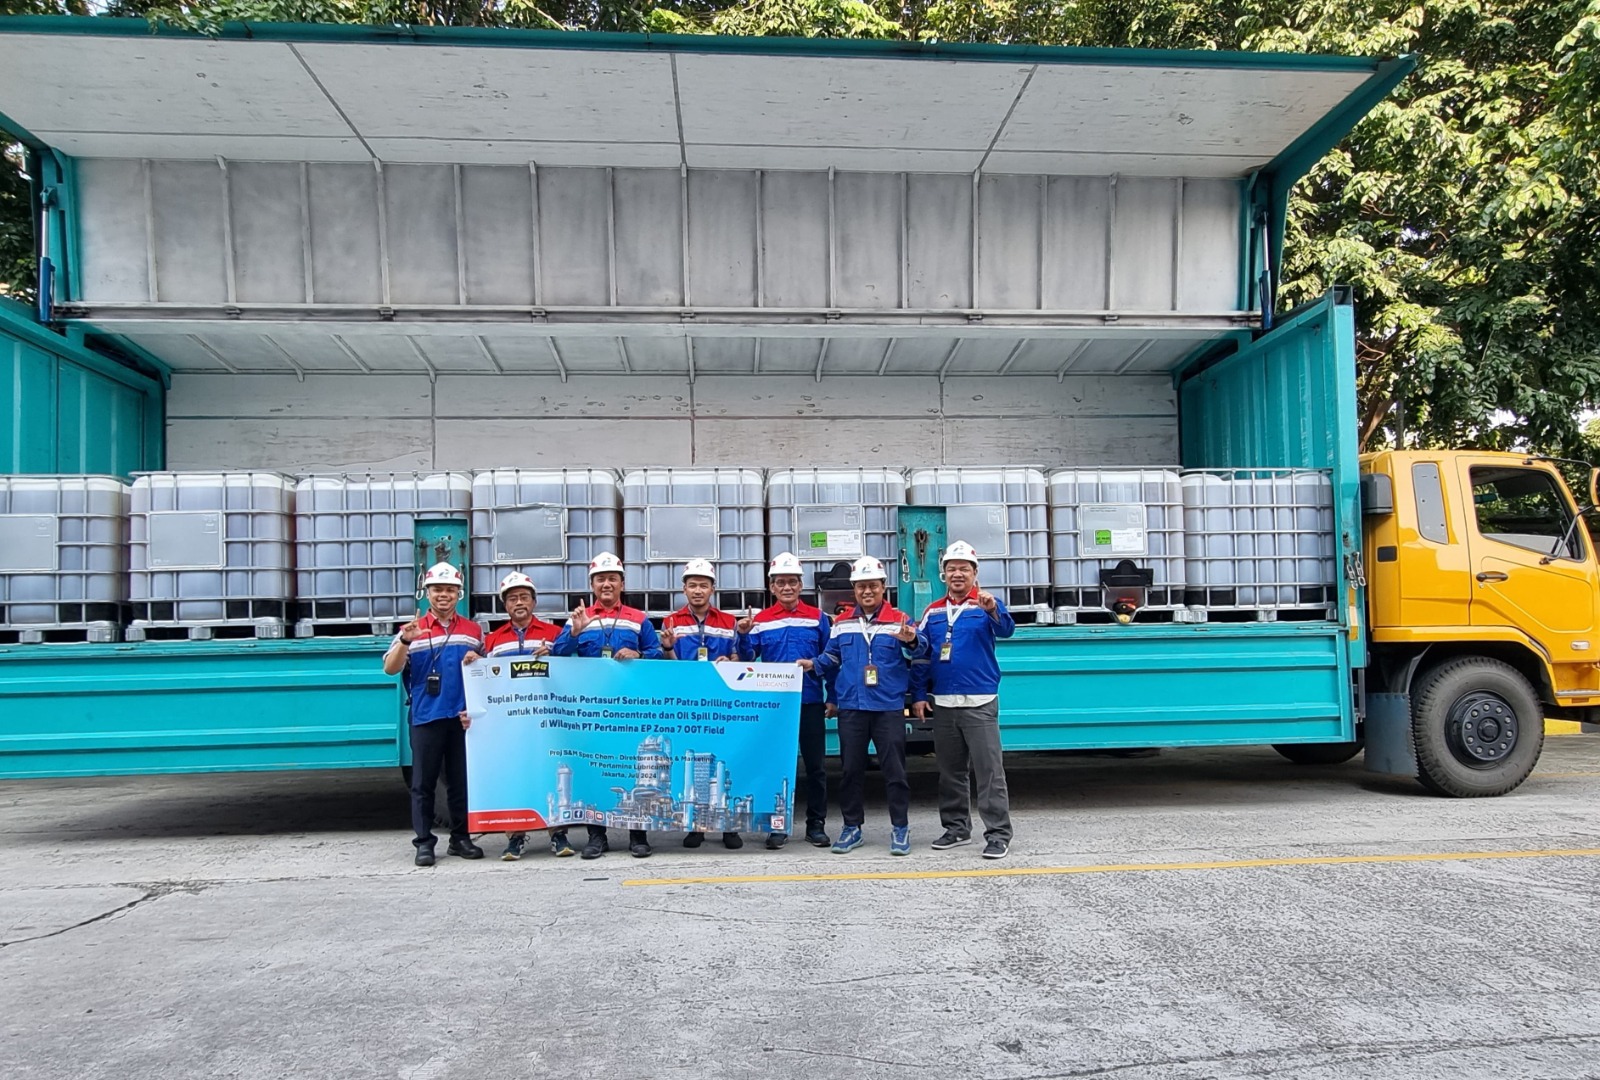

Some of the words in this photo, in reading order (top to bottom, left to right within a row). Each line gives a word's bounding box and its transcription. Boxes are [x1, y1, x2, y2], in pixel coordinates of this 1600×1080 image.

[487, 694, 513, 705] Suplai
[514, 693, 549, 702] Perdana
[550, 693, 578, 703] Produk
[579, 695, 621, 705] Pertasurf
[622, 696, 650, 705] Series
[651, 697, 662, 705] ke
[664, 697, 675, 705] PT
[676, 698, 699, 706] Patra
[700, 698, 732, 709] Drilling
[734, 699, 781, 709] Contractor
[507, 707, 531, 716] untuk
[532, 706, 576, 717] Kebutuhan
[577, 709, 601, 718] Foam
[602, 710, 657, 719] Concentrate
[658, 711, 675, 720] dan
[676, 712, 690, 720] Oil
[691, 712, 711, 722] Spill
[712, 712, 759, 722] Dispersant
[540, 720, 548, 728] di
[549, 720, 581, 731] Wilayah
[582, 723, 593, 731] PT
[594, 723, 639, 733] Pertamina
[640, 724, 652, 733] EP
[654, 724, 675, 733] Zona
[677, 725, 682, 733] 7
[684, 725, 702, 734] OGT
[703, 726, 726, 735] Field
[578, 752, 593, 760] Spec
